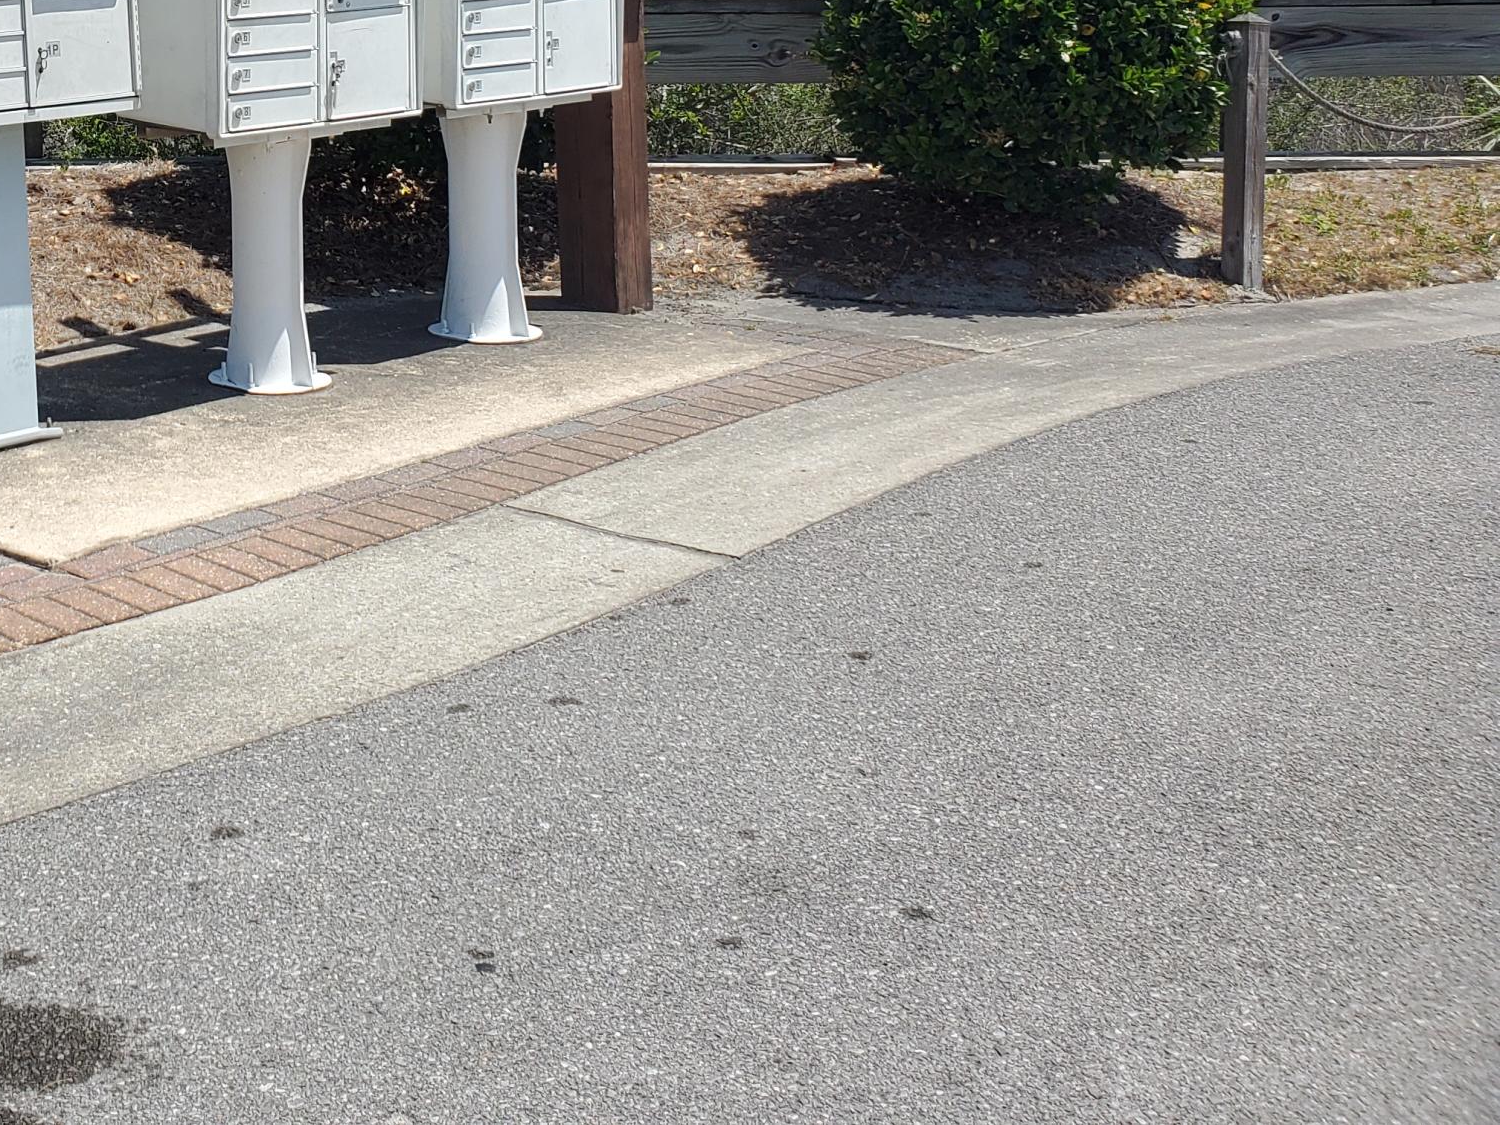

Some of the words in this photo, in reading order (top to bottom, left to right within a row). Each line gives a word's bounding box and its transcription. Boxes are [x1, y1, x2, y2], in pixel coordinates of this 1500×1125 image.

[242, 32, 248, 42] 6
[47, 44, 59, 56] 1P
[242, 69, 248, 79] 7
[243, 106, 249, 117] 8
